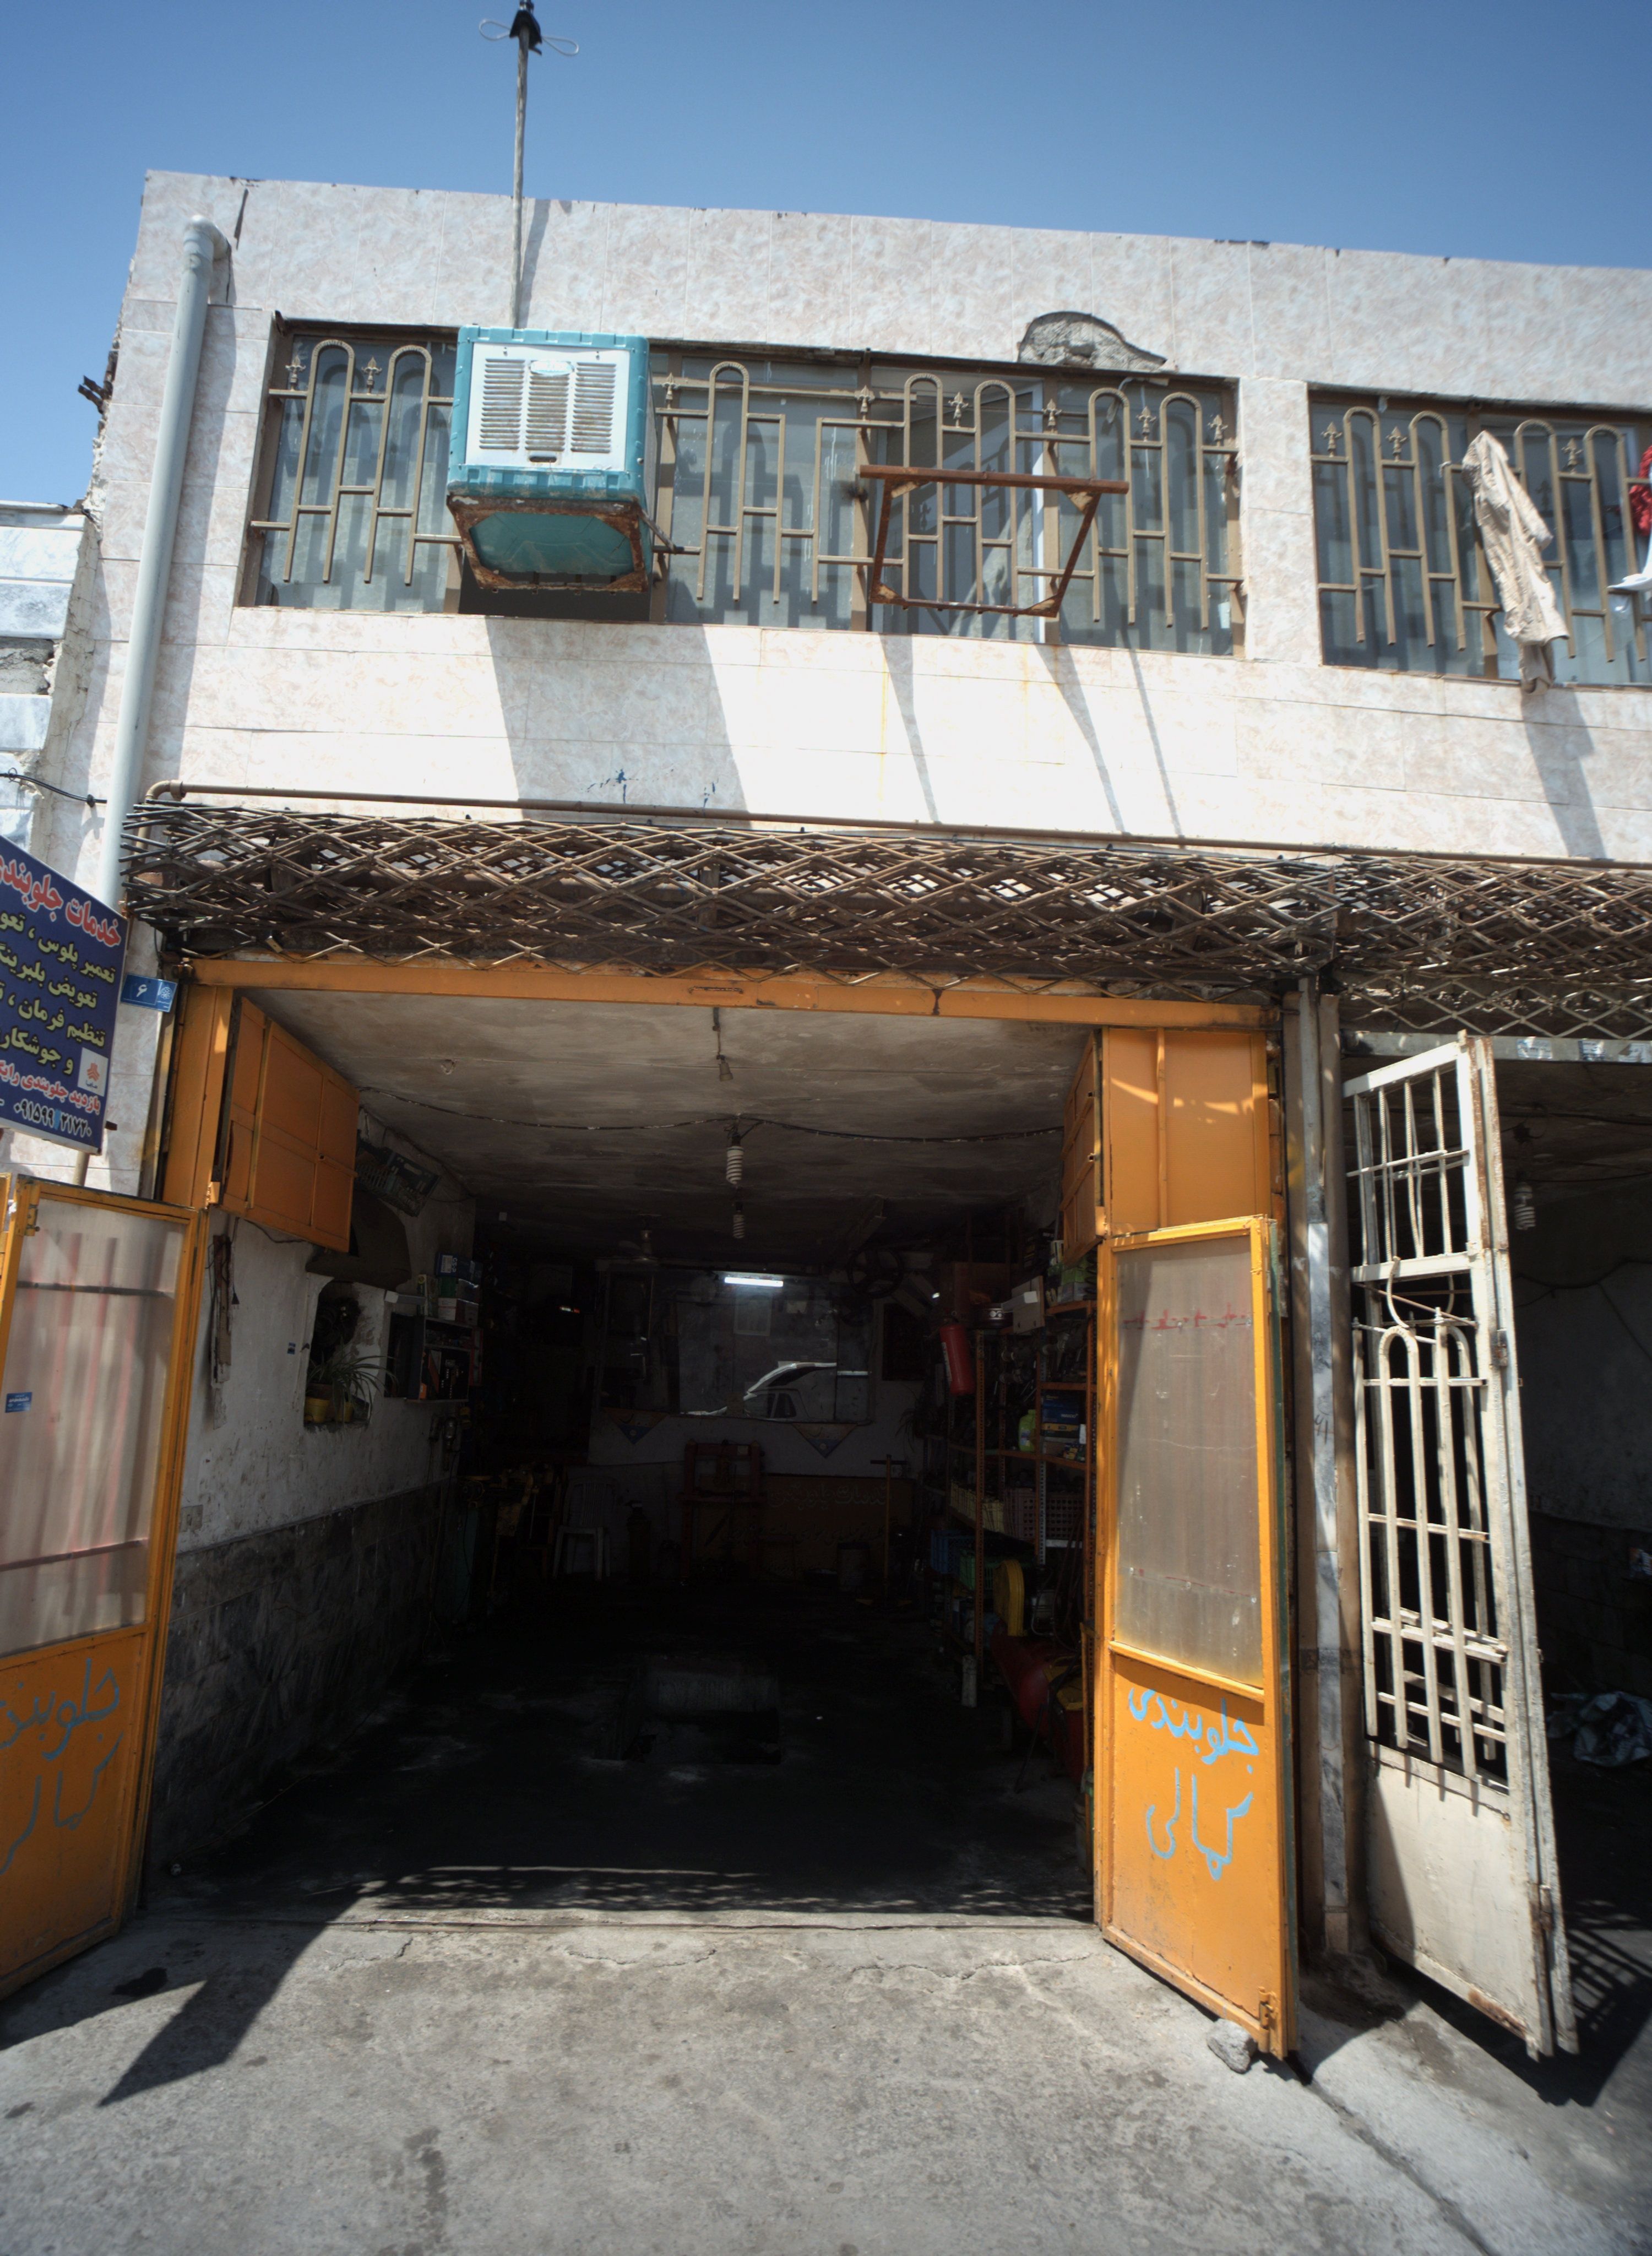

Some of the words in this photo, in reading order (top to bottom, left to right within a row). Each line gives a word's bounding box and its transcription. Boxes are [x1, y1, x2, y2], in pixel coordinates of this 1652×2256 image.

[66, 898, 121, 947] خدمات
[38, 938, 78, 969] پلوس
[80, 962, 116, 984] تعمیر
[48, 977, 97, 1008] تعویض
[136, 984, 148, 997] ۶
[19, 999, 64, 1031] فرمان
[67, 1023, 105, 1046] تنظیم
[63, 1059, 73, 1075] و
[21, 1075, 68, 1103] جلوبندی
[69, 1091, 100, 1115] بازدید
[0, 1658, 119, 1761] جلوبند
[1128, 1688, 1259, 1774] جلوبندی
